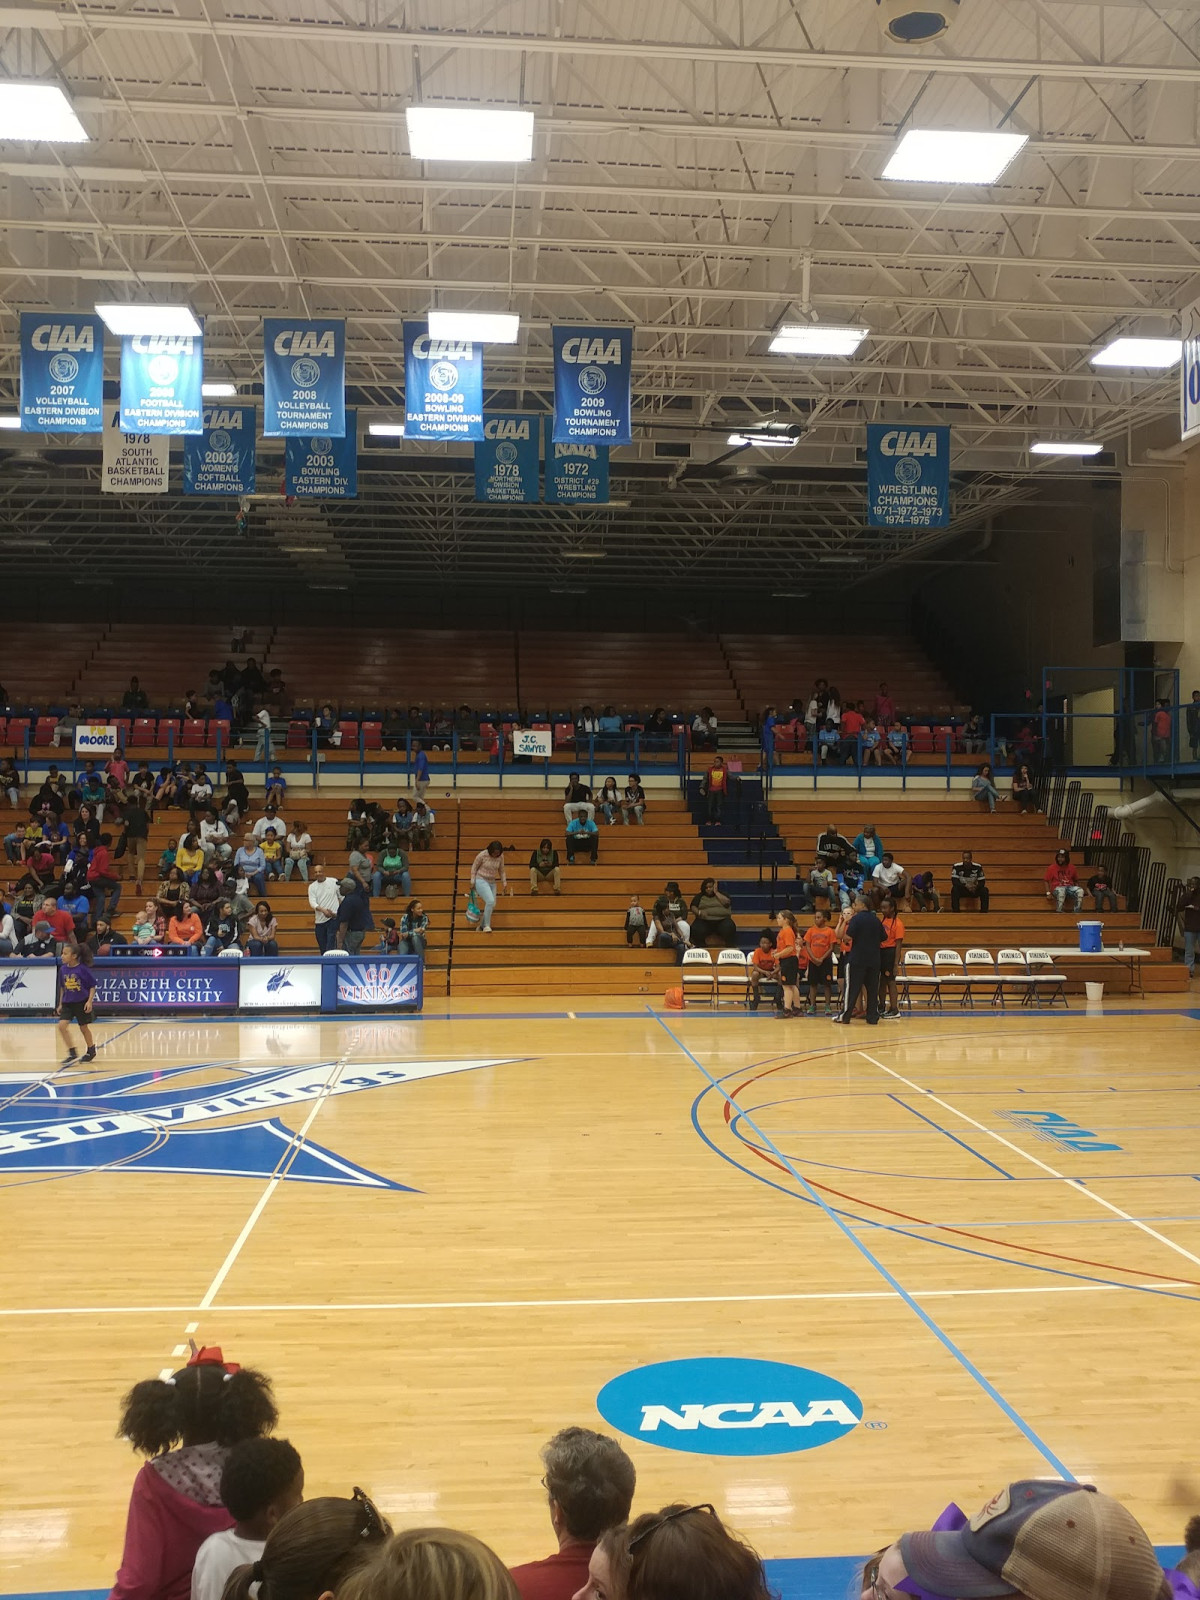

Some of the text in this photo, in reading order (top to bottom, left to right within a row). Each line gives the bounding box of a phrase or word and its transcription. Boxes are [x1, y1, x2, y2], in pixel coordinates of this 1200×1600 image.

[31, 325, 94, 353] CIAA
[274, 330, 335, 358] CIAA
[131, 335, 194, 355] CIAA
[412, 333, 473, 361] CIAA
[561, 337, 622, 365] CIAA
[50, 385, 75, 395] 2007
[292, 390, 317, 400] 2008
[35, 397, 89, 406] VOLLEYBALL
[140, 399, 184, 408] FOOTBALL
[278, 401, 331, 410] VOLLEYBALL
[581, 397, 605, 407] 2009
[24, 407, 100, 416] EASTERN DIVISION
[124, 408, 199, 418] EASTERN DIVISION
[425, 404, 464, 413] BOWLING
[573, 408, 612, 417] BOWLING
[276, 411, 333, 420] TOURNAMENT
[407, 413, 482, 423] EASTERN DIVISION
[38, 417, 87, 425] CHAMPIONS
[137, 419, 186, 428] CHAMPIONS
[280, 421, 329, 430] CHAMPIONS
[565, 418, 621, 427] TOURNAMENT
[420, 423, 469, 432] CHAMPIONS
[484, 420, 530, 440] CIAA
[568, 428, 617, 436] CHAMPIONS
[124, 433, 151, 444] 1978
[880, 430, 937, 457] CIAA
[122, 448, 152, 456] SOUTH
[205, 451, 233, 463] 2002
[115, 457, 159, 466] ATLANTIC
[306, 455, 334, 467] 2003
[107, 467, 165, 475] BASKETBALL
[200, 464, 239, 473] WOMEN'S
[301, 467, 340, 476] BOWLING
[493, 464, 520, 476] 1978
[563, 462, 589, 475] 1972
[110, 477, 163, 486] CHAMPIONS
[197, 473, 241, 482] SOFTBALL
[292, 476, 349, 486] EASTERN DIV.
[194, 482, 244, 492] CHAMPIONS
[296, 485, 345, 495] CHAMPIONS
[878, 485, 938, 495] WRESTLING
[556, 491, 597, 499] CHAMPIONS
[877, 495, 938, 506] CHAMPIONS
[79, 735, 115, 746] MOORE
[518, 744, 547, 754] SAWYER
[721, 952, 743, 960] VIKINGS
[908, 953, 929, 961] VIKINGS
[365, 967, 391, 983] GO
[95, 978, 170, 990] LIZABETH
[176, 978, 213, 990] CITY
[92, 991, 223, 1002] ATE UNIVERSITY
[0, 1121, 120, 1149] SU
[639, 1400, 861, 1431] NCAA
